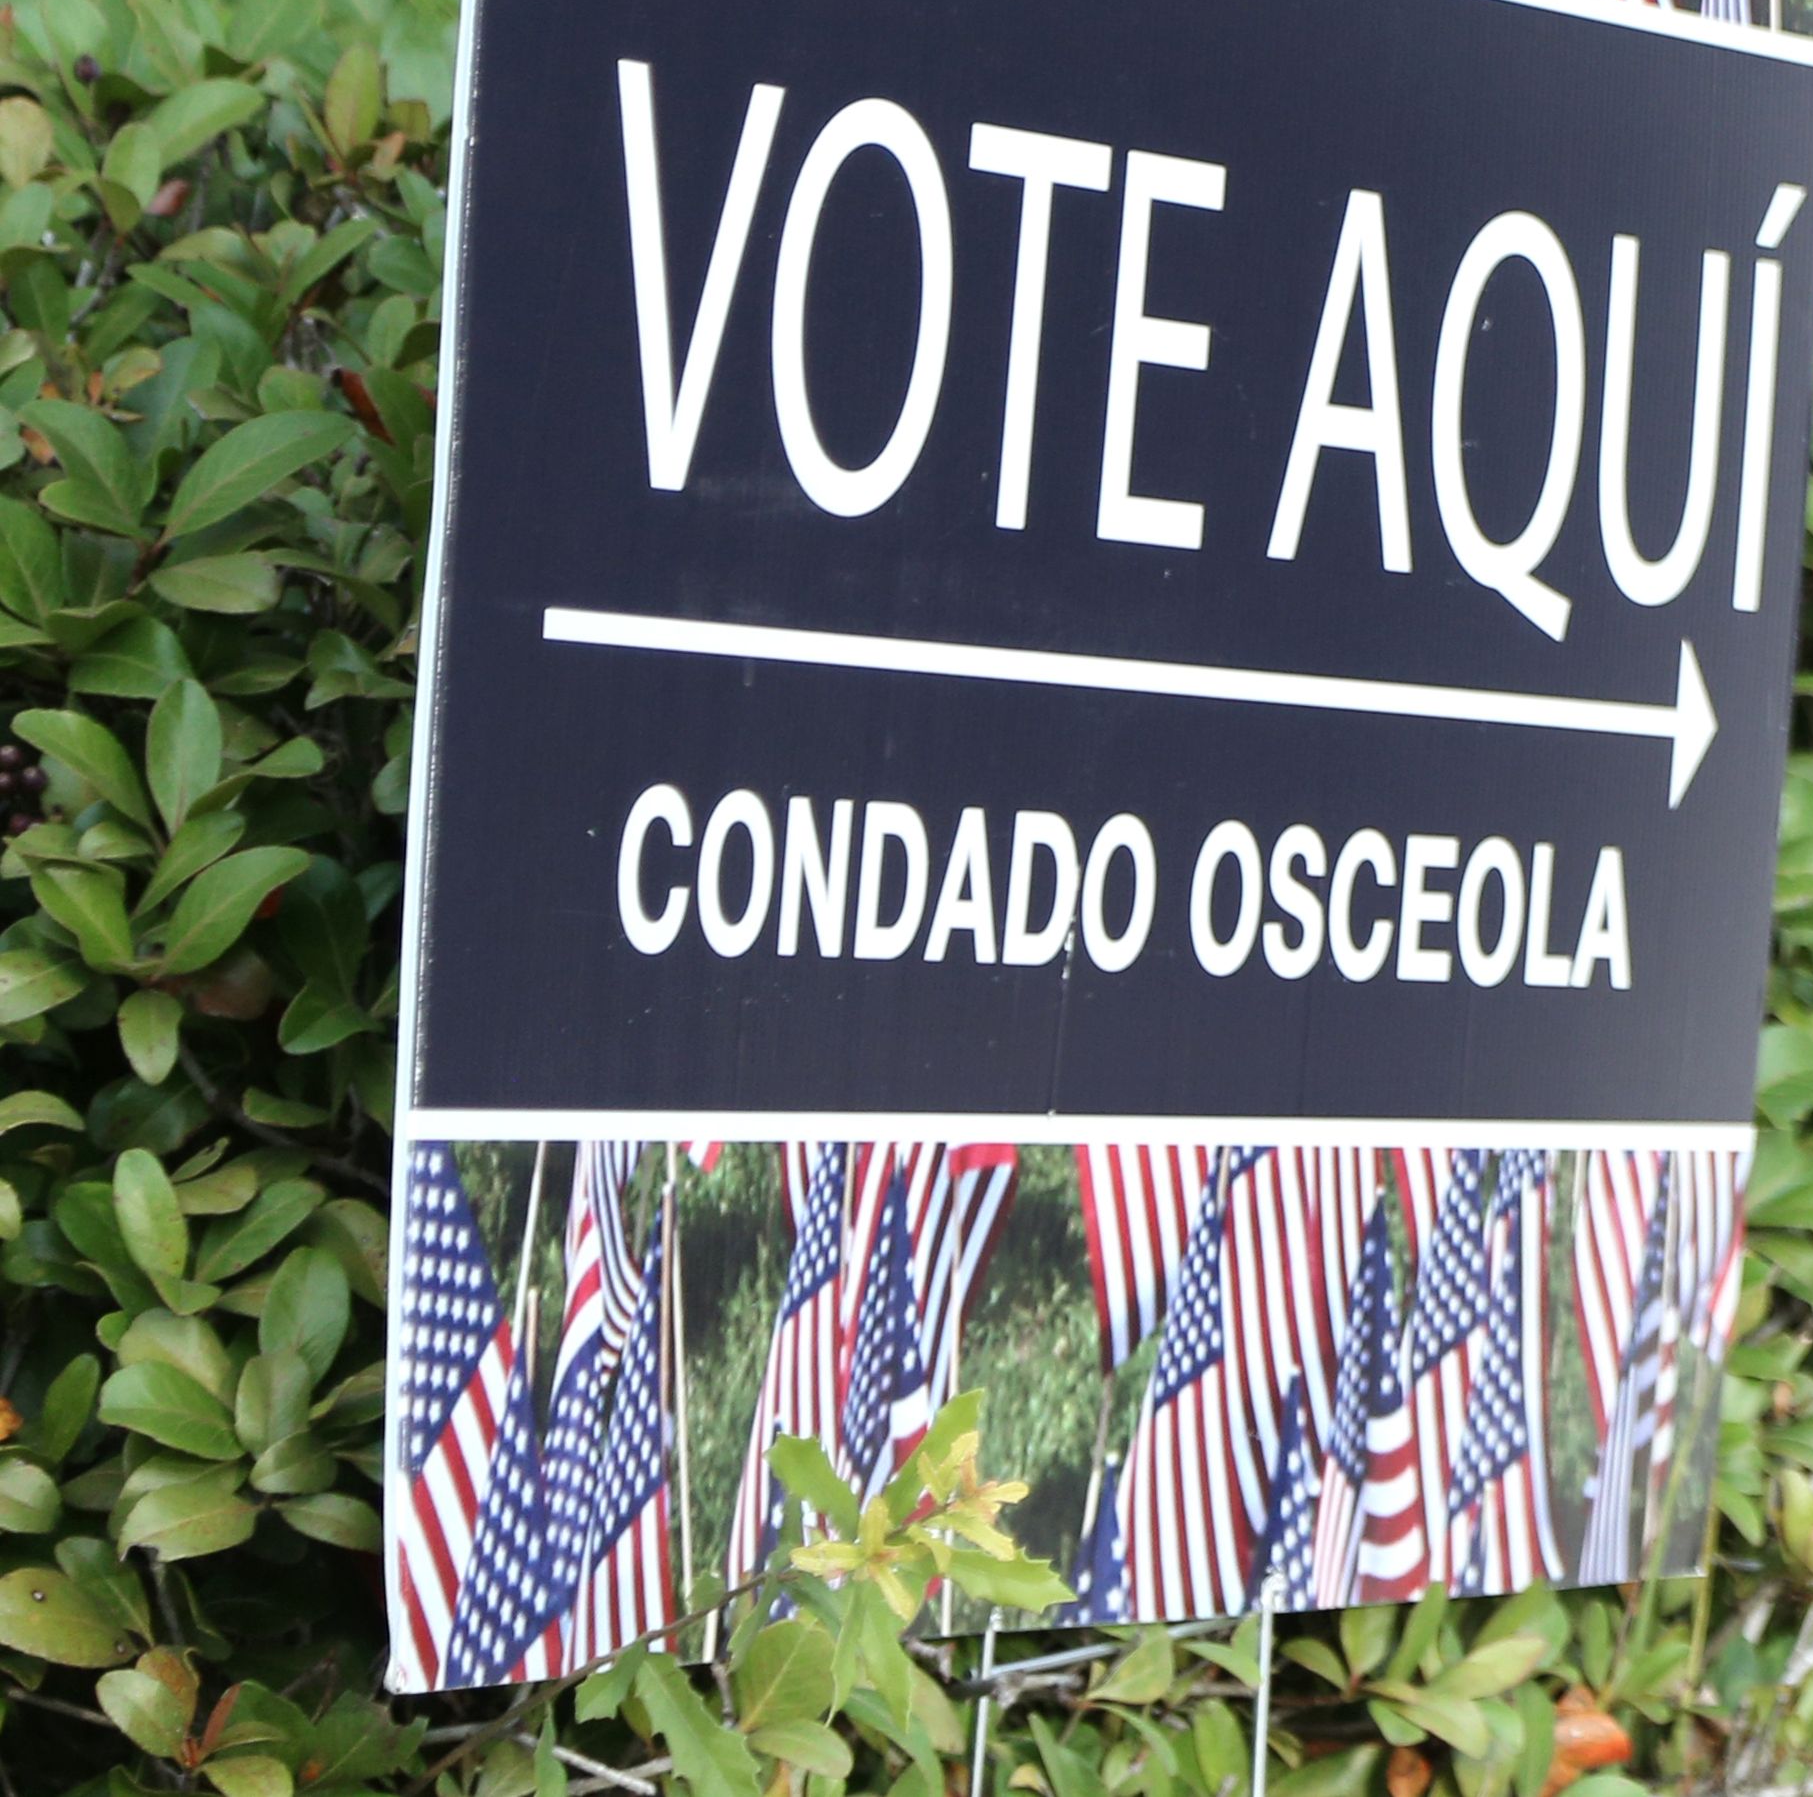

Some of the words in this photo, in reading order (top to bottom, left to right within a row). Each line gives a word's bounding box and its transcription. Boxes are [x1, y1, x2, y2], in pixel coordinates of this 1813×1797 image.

[617, 58, 1226, 550] VOTE
[1266, 184, 1806, 642] AQUÍ
[617, 783, 1157, 973] CONDADO
[1190, 820, 1632, 990] OSCEOLA
